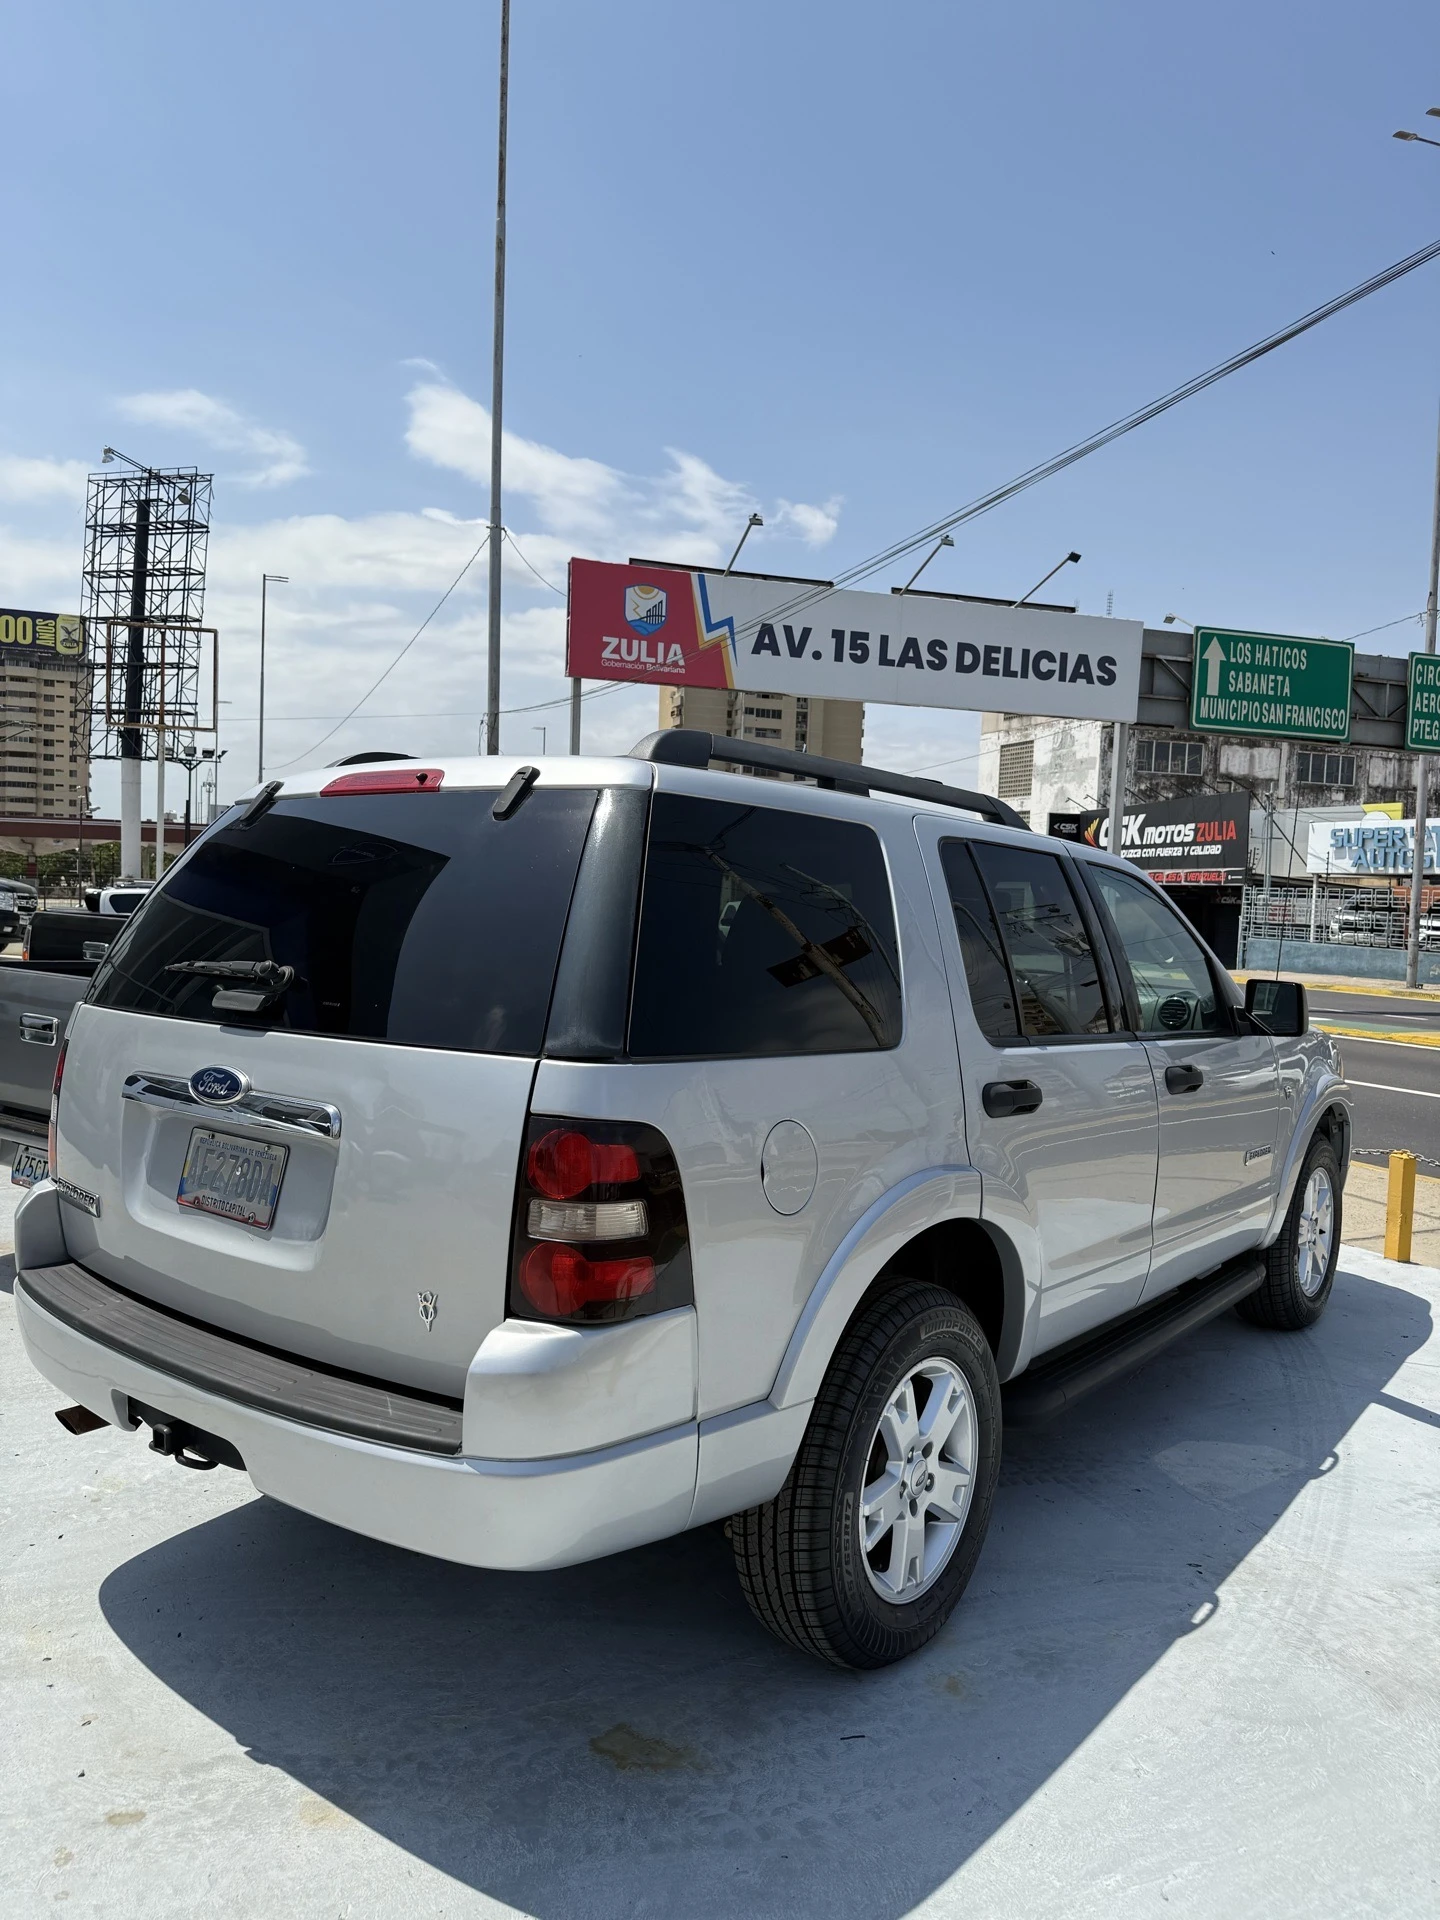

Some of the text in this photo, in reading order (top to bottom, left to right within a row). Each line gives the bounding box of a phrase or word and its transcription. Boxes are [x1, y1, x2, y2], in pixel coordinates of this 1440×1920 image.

[36, 618, 55, 647] AÑOS
[602, 636, 685, 666] ZULIA
[751, 623, 1117, 686] AV. 15 LAS DELICIAS
[1230, 641, 1307, 671] LOS HATICOS
[601, 659, 686, 674] Gobernación Bolivariana
[1228, 670, 1291, 697] SABANETA
[1200, 697, 1345, 730] MUNICIPIO SAN FRANCISCO
[1196, 820, 1236, 842] ZULIA
[1330, 826, 1406, 848] SUPER
[1184, 846, 1190, 856] Y
[199, 1069, 231, 1096] Ford
[924, 1319, 984, 1349] WINDFORCE
